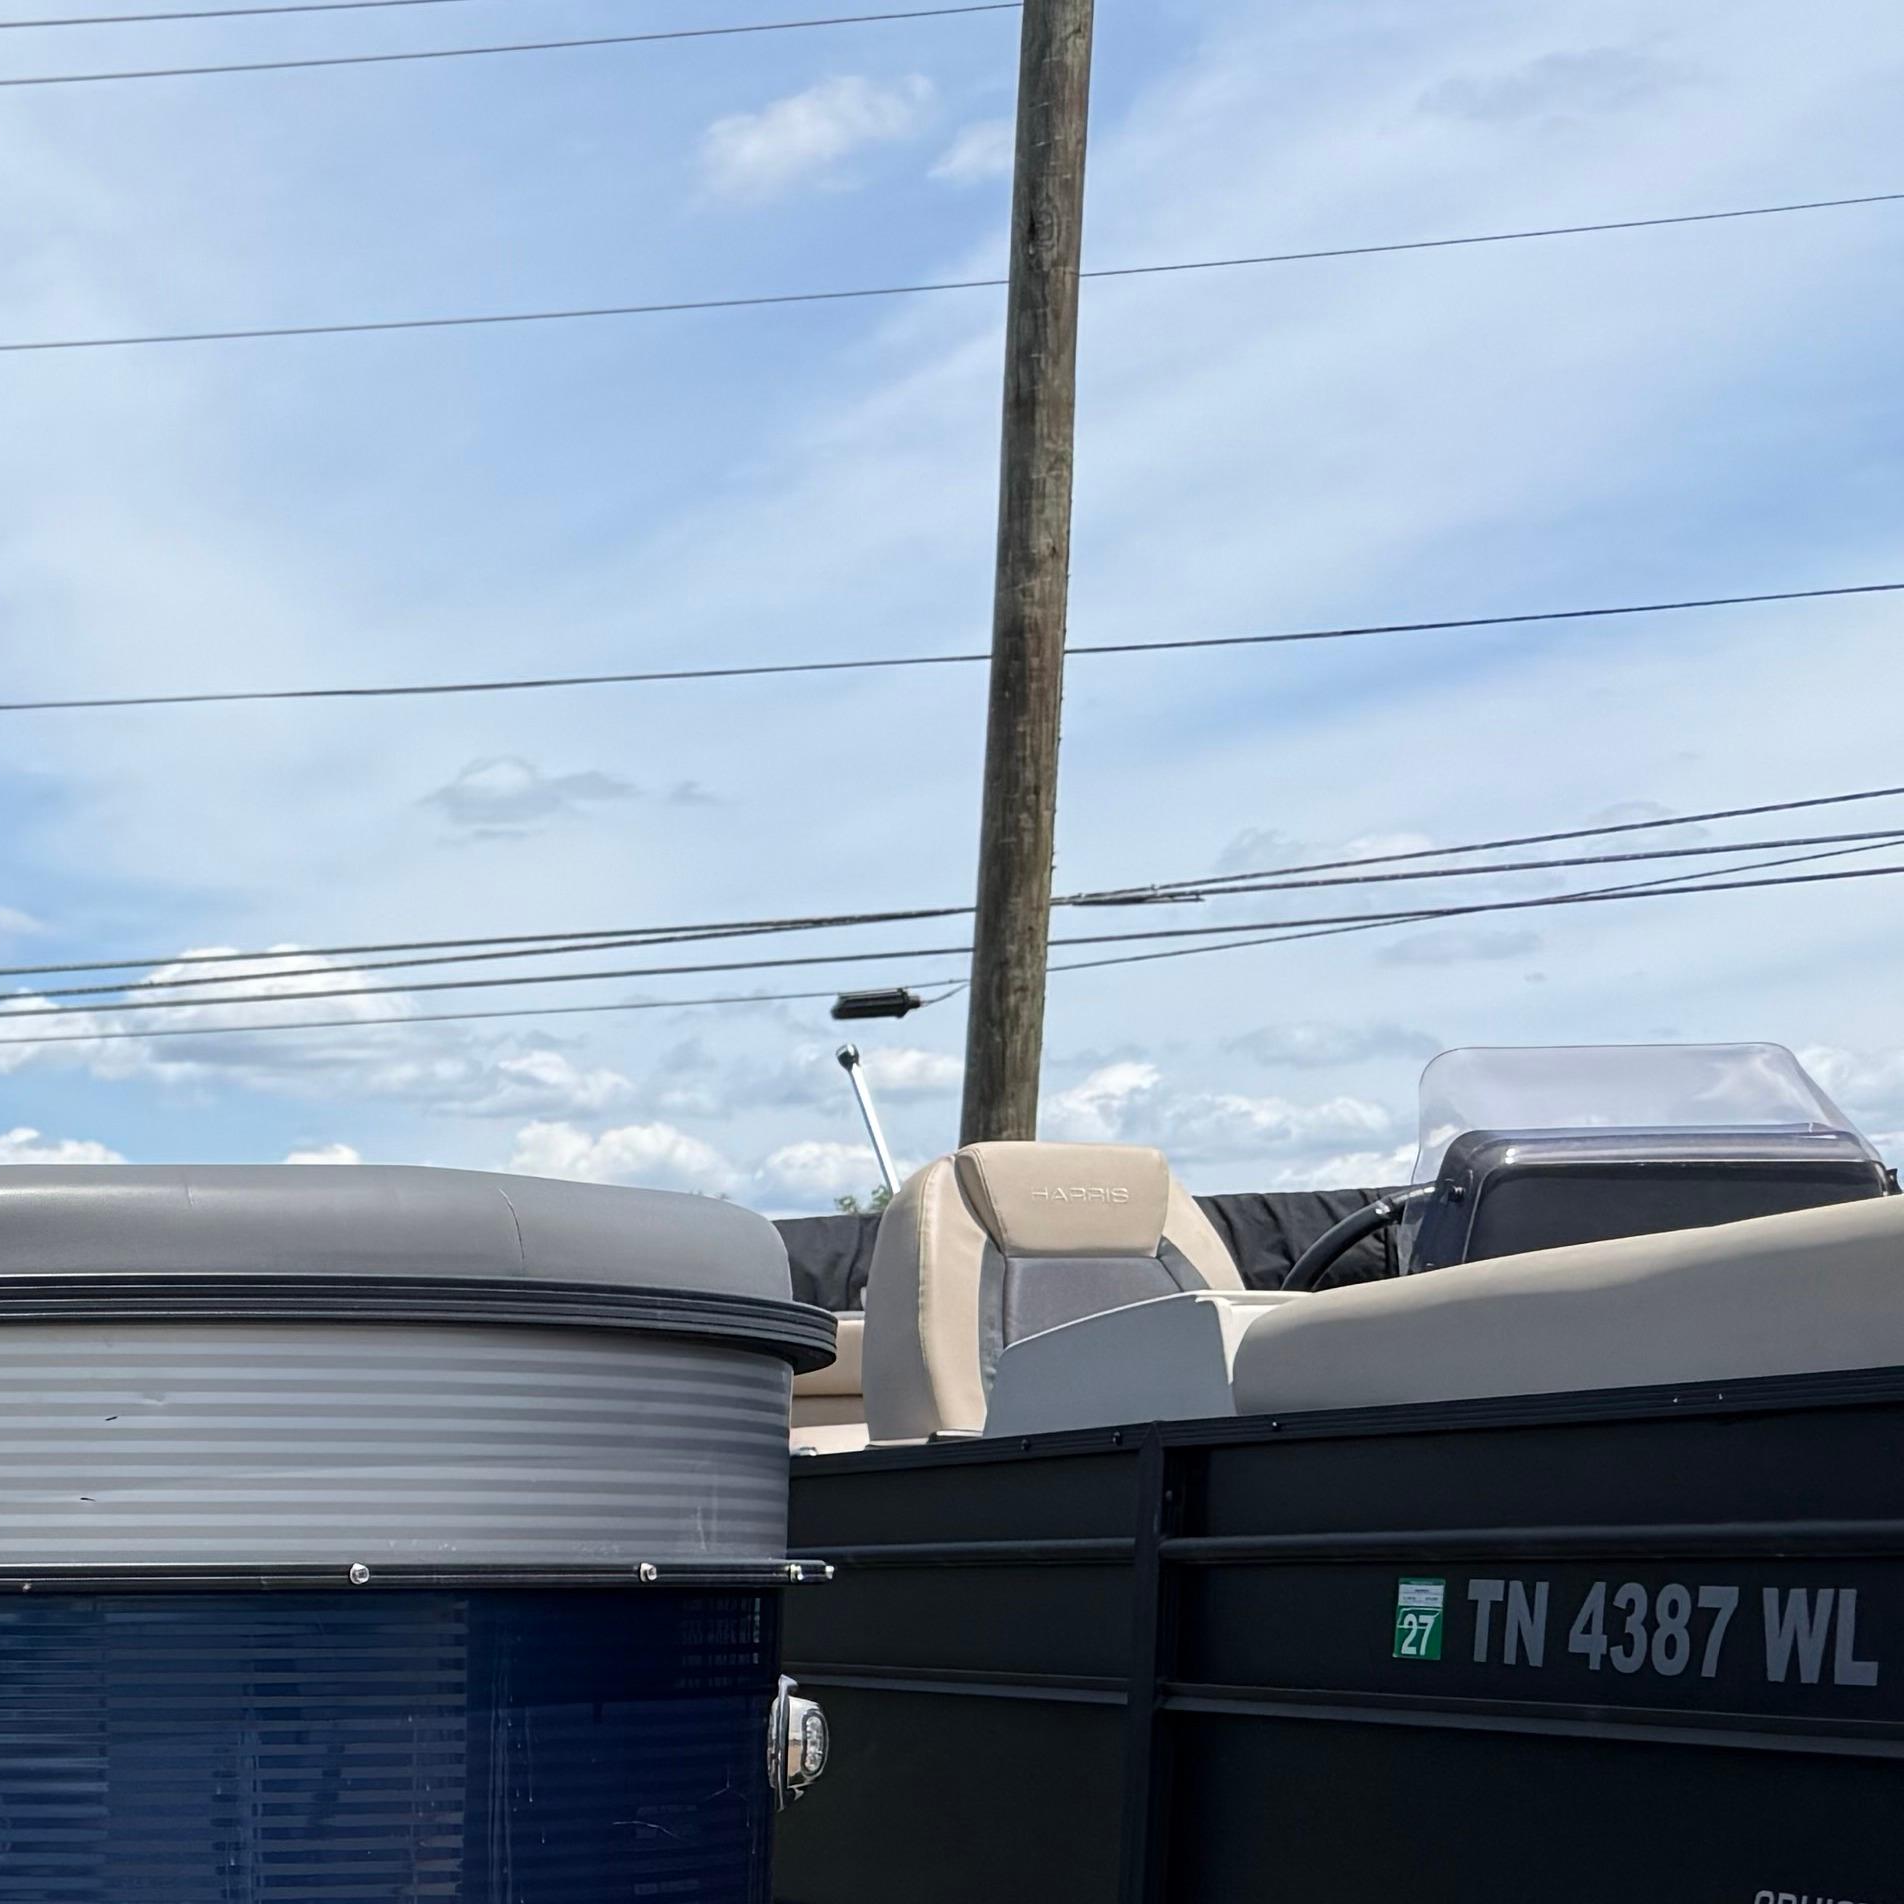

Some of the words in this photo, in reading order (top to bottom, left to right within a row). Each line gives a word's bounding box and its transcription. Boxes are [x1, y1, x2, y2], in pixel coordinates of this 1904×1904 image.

[1032, 1186, 1129, 1203] HARRIS
[1400, 1613, 1436, 1656] 27
[1467, 1578, 1550, 1667] TN
[1567, 1581, 1740, 1678] 4387
[1762, 1587, 1879, 1686] WL
